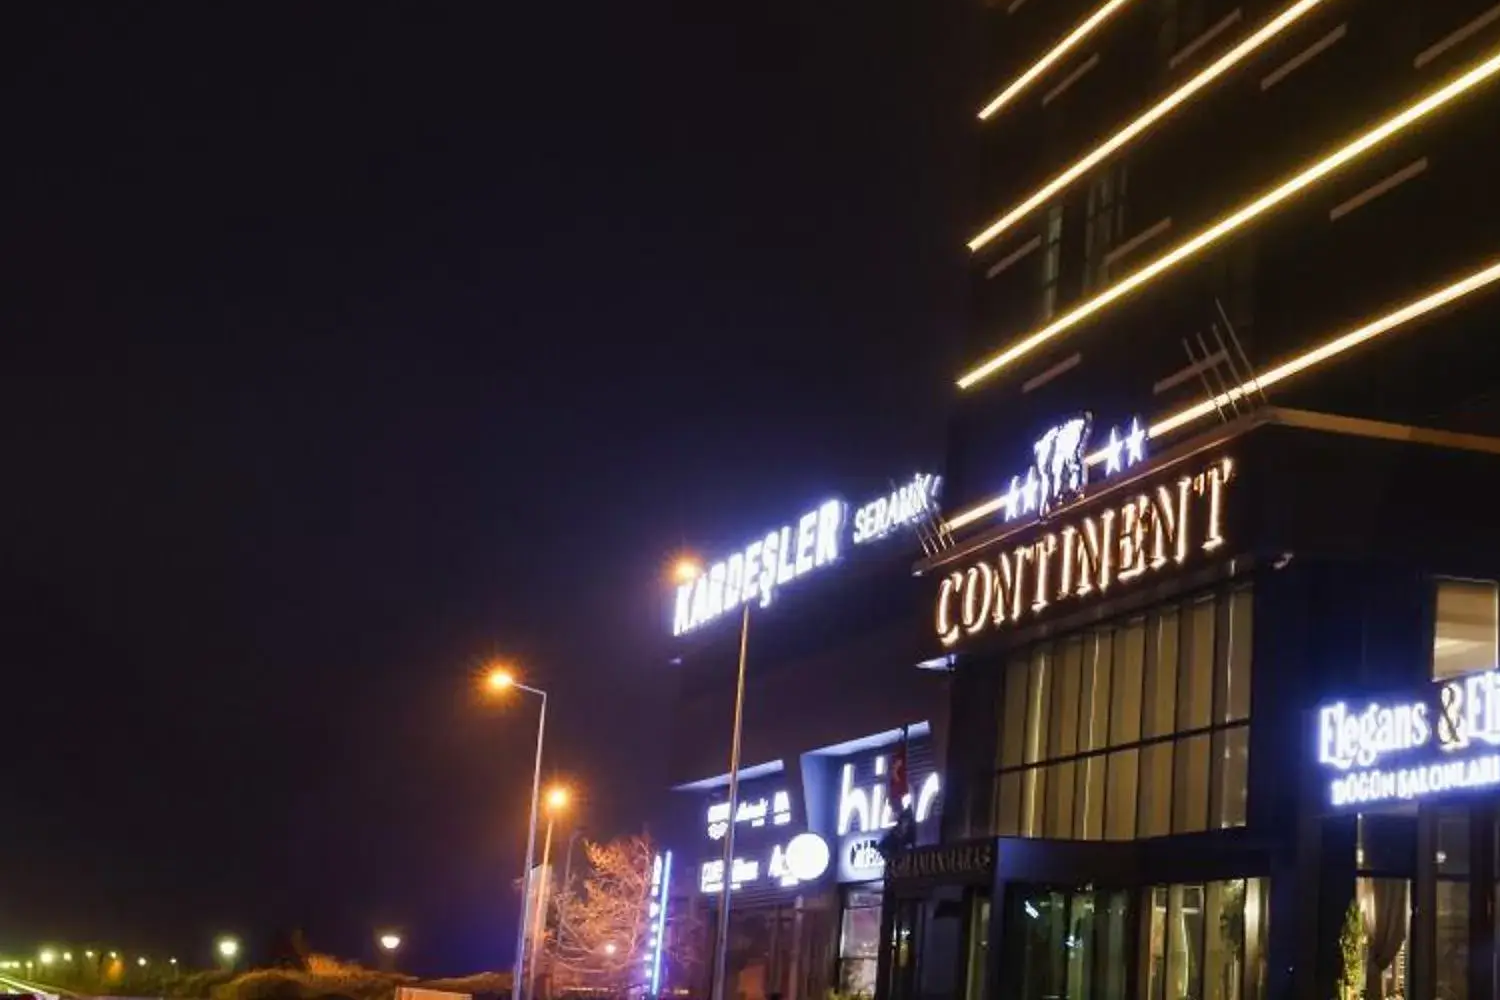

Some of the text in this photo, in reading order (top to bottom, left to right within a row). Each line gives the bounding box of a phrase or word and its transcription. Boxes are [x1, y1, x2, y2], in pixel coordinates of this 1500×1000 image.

[935, 455, 1237, 648] CONTINENT
[1318, 700, 1432, 770] Elegans
[1437, 682, 1469, 753] &
